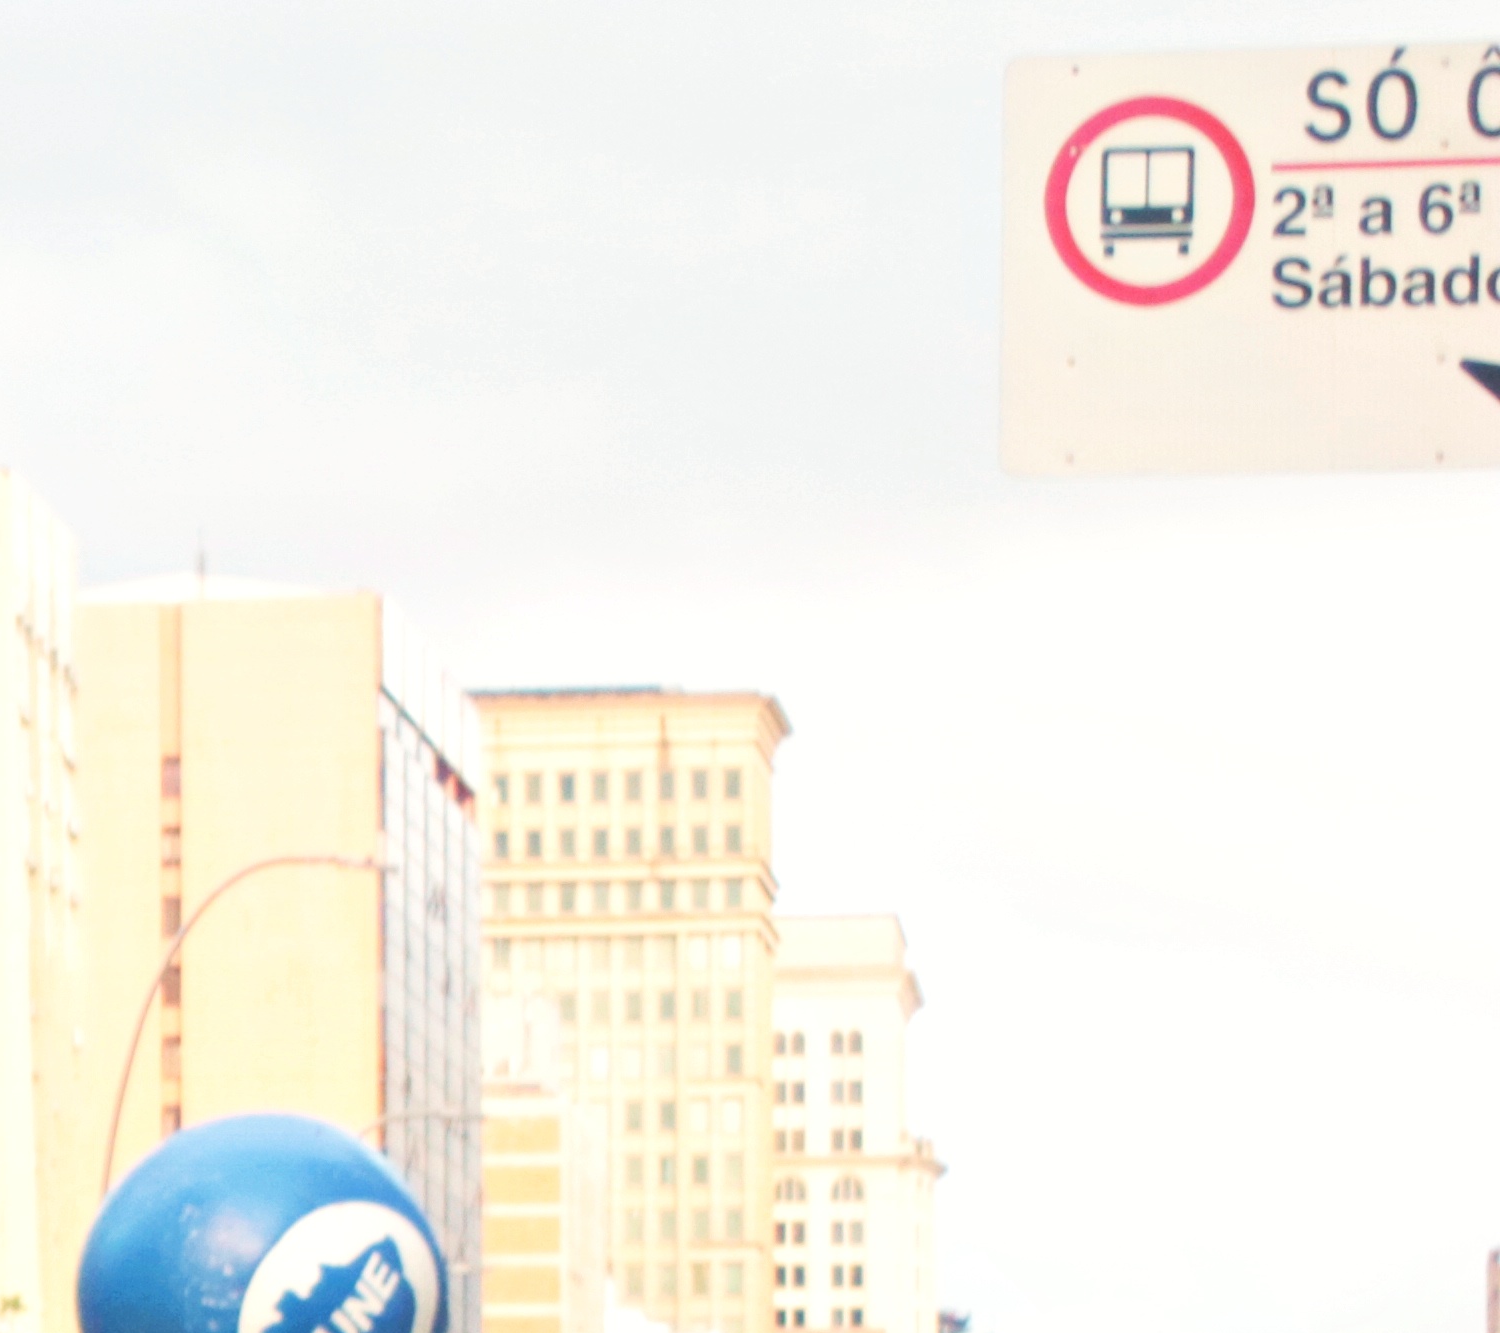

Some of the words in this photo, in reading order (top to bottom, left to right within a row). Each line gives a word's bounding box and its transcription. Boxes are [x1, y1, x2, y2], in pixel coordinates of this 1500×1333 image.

[1304, 44, 1419, 143] SÓ
[1271, 185, 1335, 238] 2ª
[1357, 194, 1393, 236] a
[1417, 180, 1481, 236] 6ª
